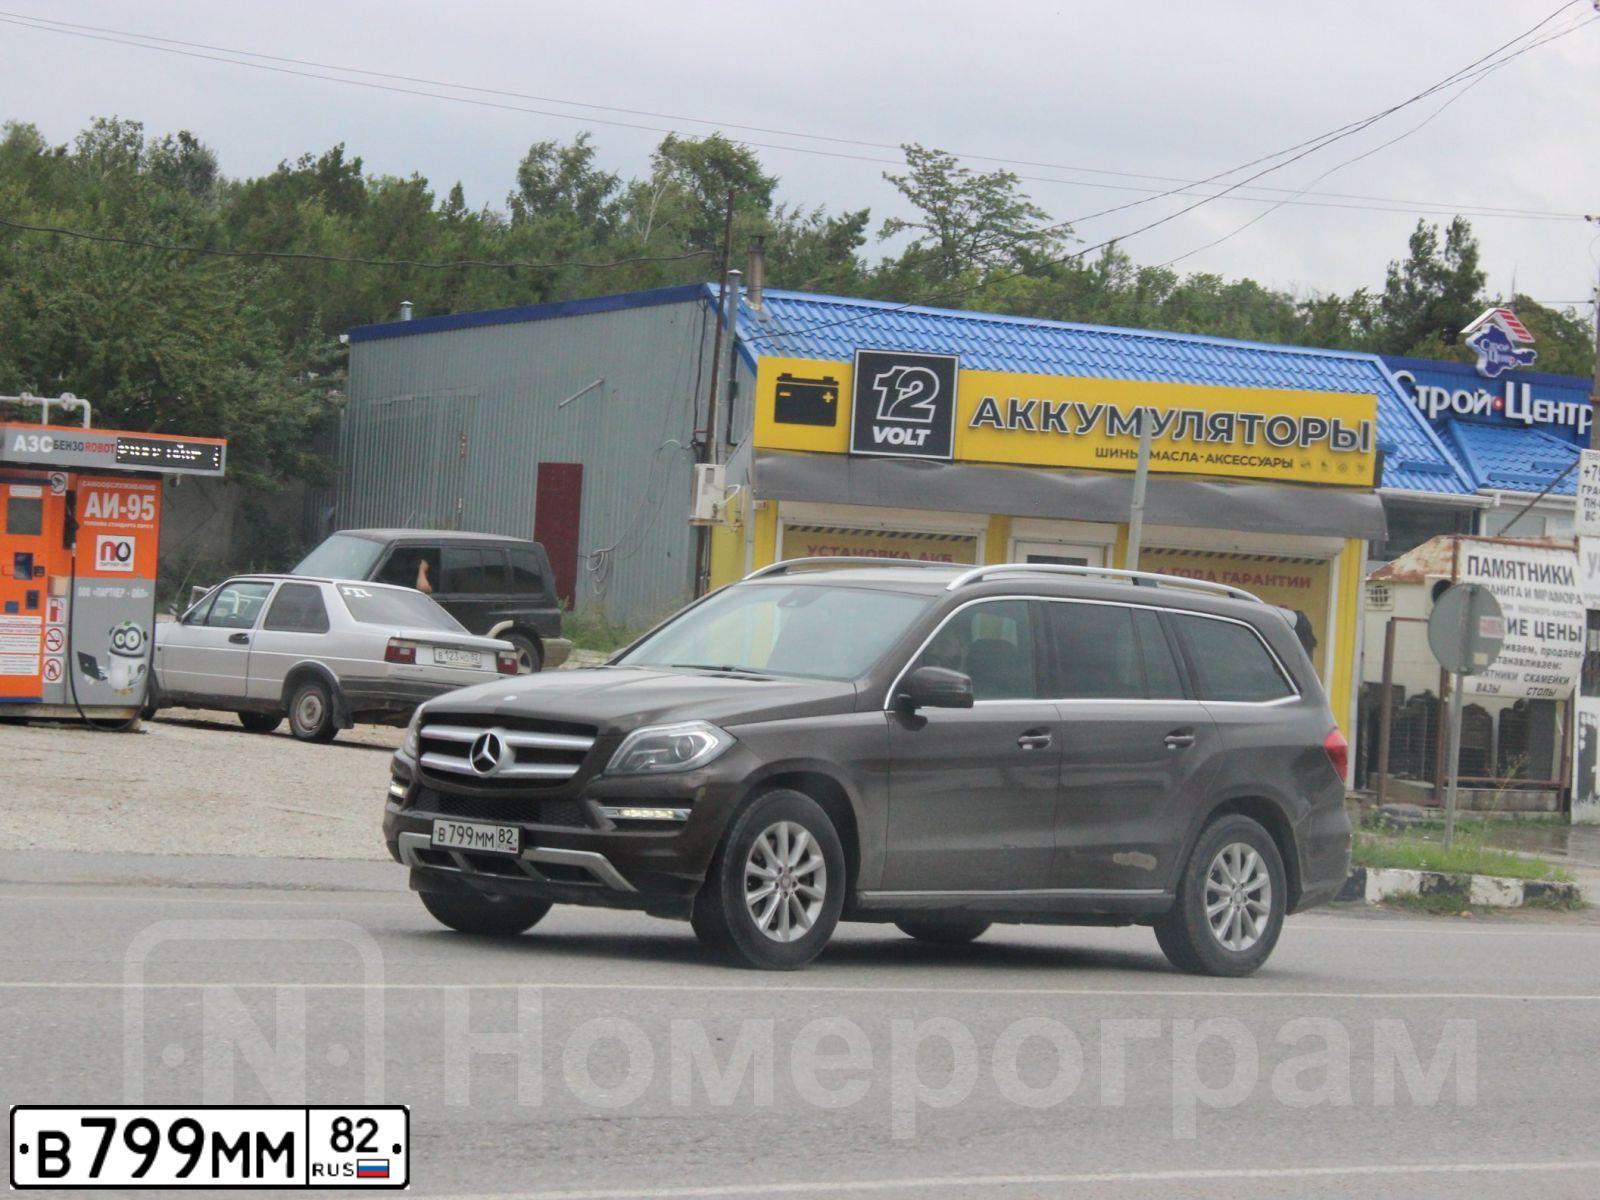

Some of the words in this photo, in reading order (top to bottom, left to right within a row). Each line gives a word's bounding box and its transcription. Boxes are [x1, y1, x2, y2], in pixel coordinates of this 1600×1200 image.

[873, 365, 939, 423] 12
[968, 395, 1371, 453] АККУМУЛЯТОРЫ
[14, 435, 53, 453] АЗС
[873, 425, 931, 446] VOLT
[1150, 450, 1199, 463] МАСЛА
[1205, 452, 1293, 468] АКСЕССУАРЫ
[84, 491, 155, 522] АИ-95
[919, 551, 953, 563] АКБ
[1222, 571, 1312, 589] ГАРАНТИИ
[1467, 555, 1576, 587] ПАМЯТНИКИ
[1507, 618, 1528, 637] ИЕ
[1534, 620, 1582, 643] ЦЕНЫ
[1526, 686, 1558, 697] СТОЛЫ
[438, 824, 494, 848] В799ММ
[498, 828, 513, 844] 82
